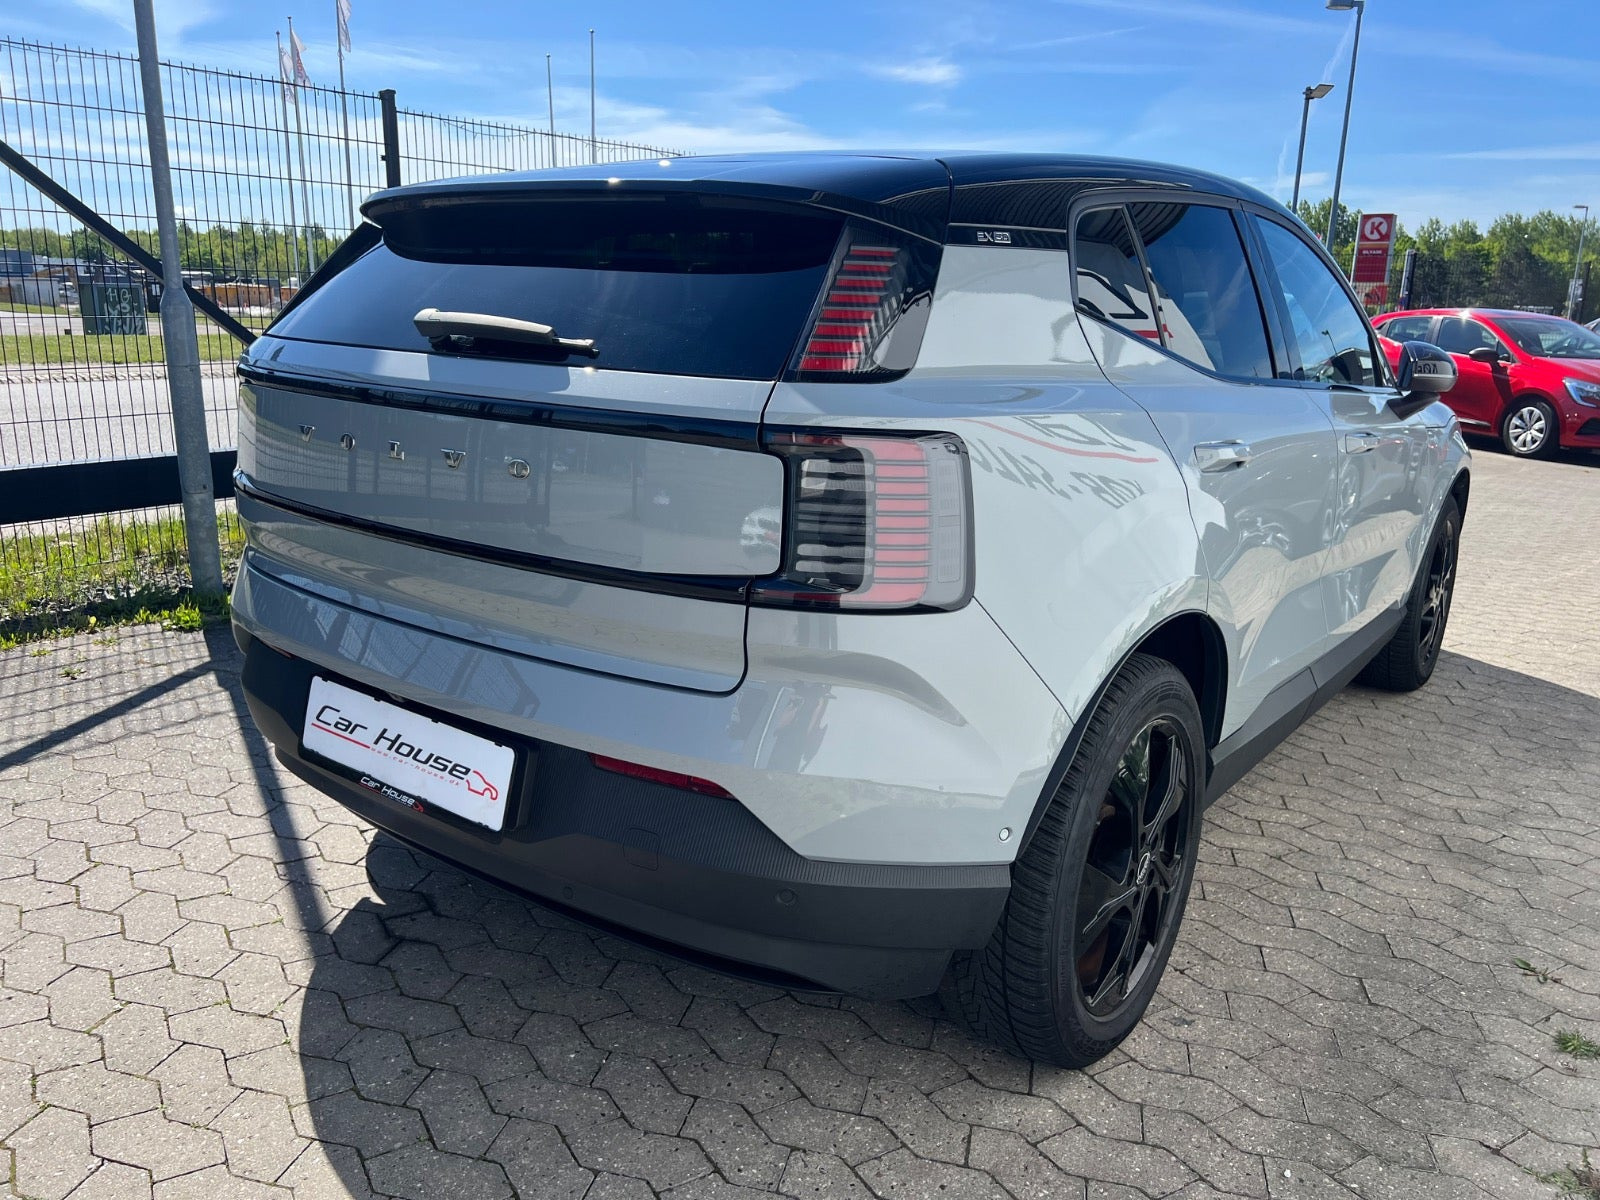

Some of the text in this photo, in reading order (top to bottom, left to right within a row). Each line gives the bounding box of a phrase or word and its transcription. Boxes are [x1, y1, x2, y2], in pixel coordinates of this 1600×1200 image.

[299, 424, 531, 480] VOLVO
[315, 705, 471, 781] Car House
[360, 776, 380, 789] Car
[381, 785, 416, 806] House
